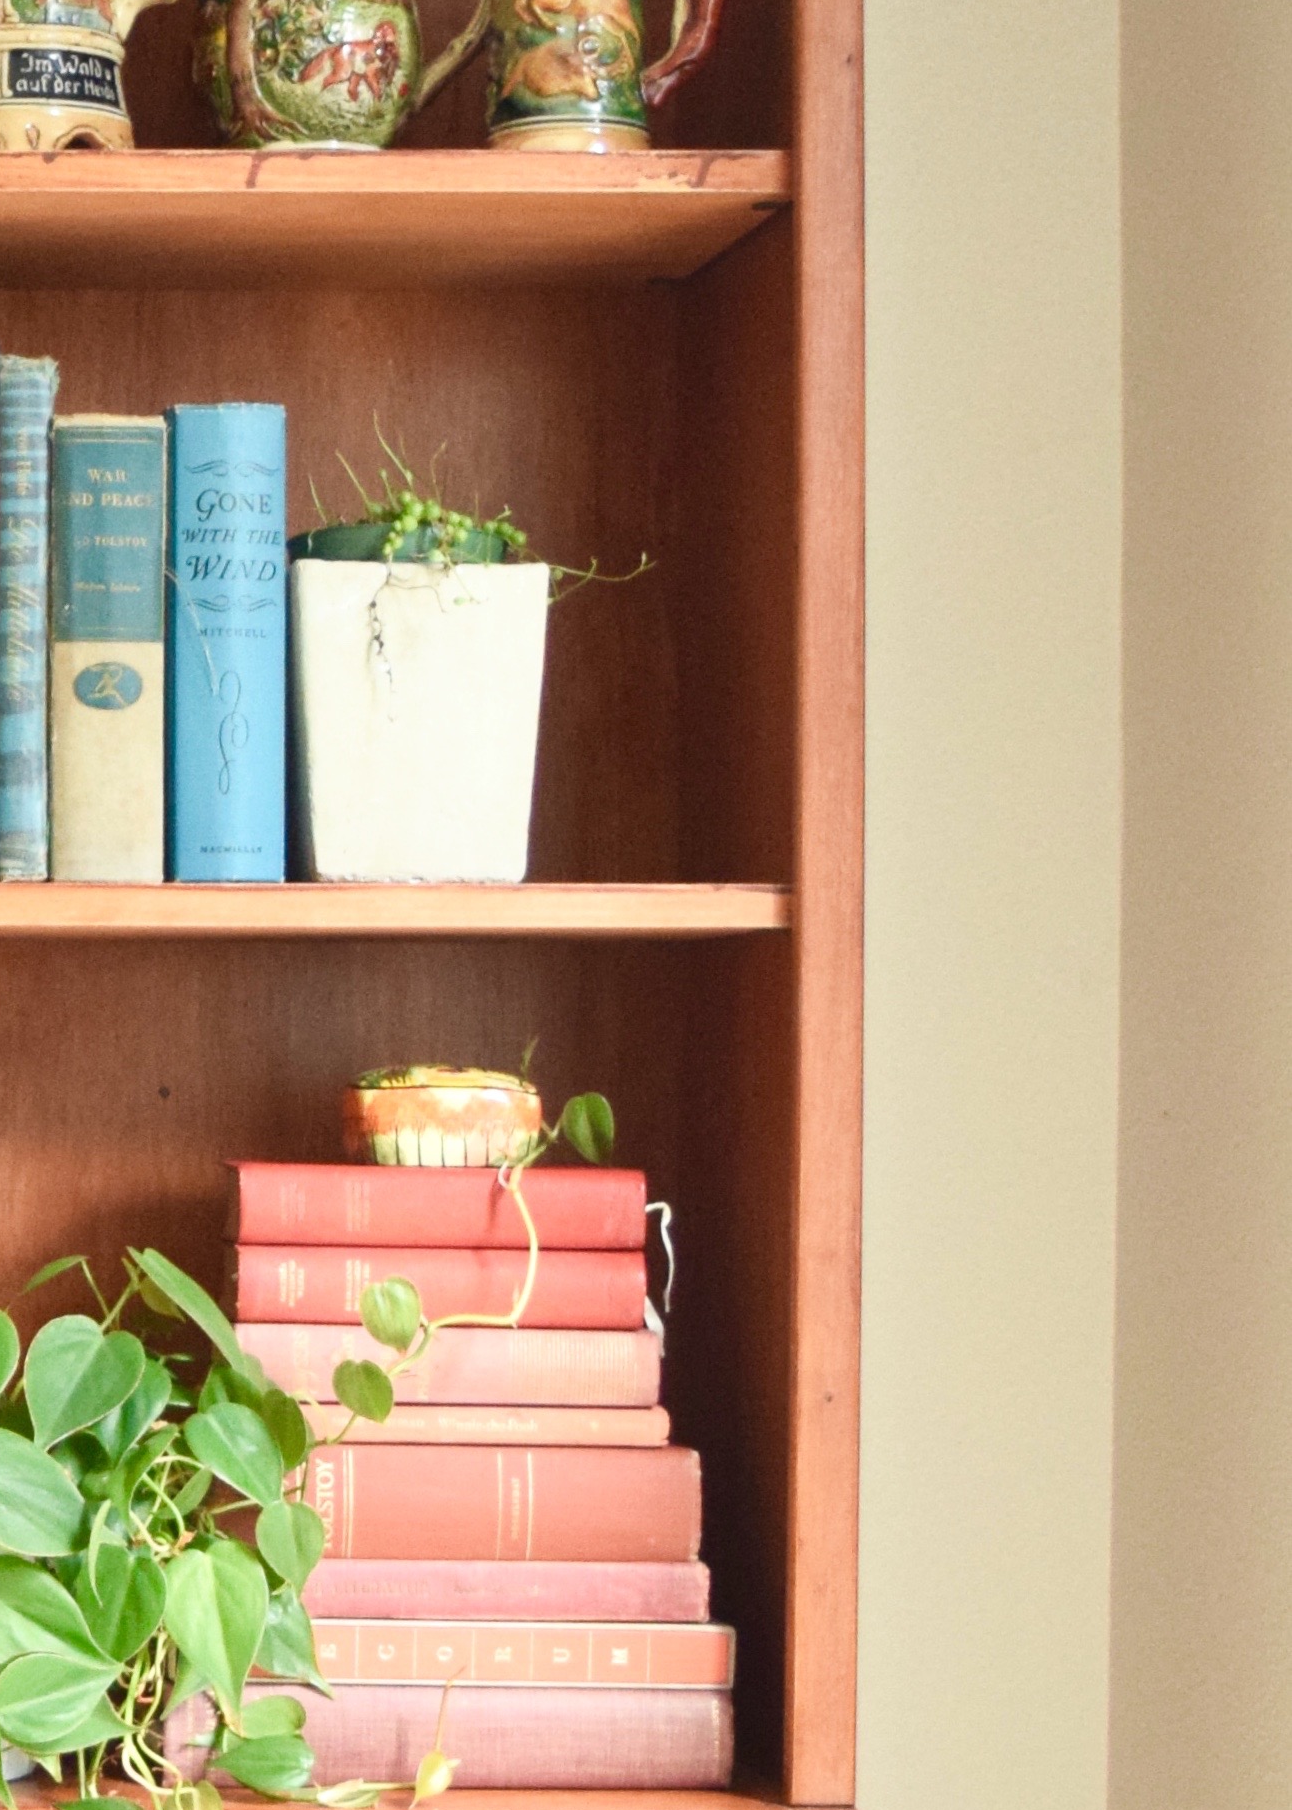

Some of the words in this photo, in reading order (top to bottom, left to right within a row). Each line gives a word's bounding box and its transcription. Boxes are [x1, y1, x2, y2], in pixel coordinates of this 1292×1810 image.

[15, 73, 51, 92] auf
[54, 73, 81, 95] der
[87, 468, 128, 484] WAR
[195, 488, 273, 523] GONE
[94, 536, 148, 548] TOLSTOY
[181, 527, 237, 545] WITH
[247, 528, 283, 546] THE
[185, 554, 277, 582] WIND
[198, 628, 267, 639] MITCHELL
